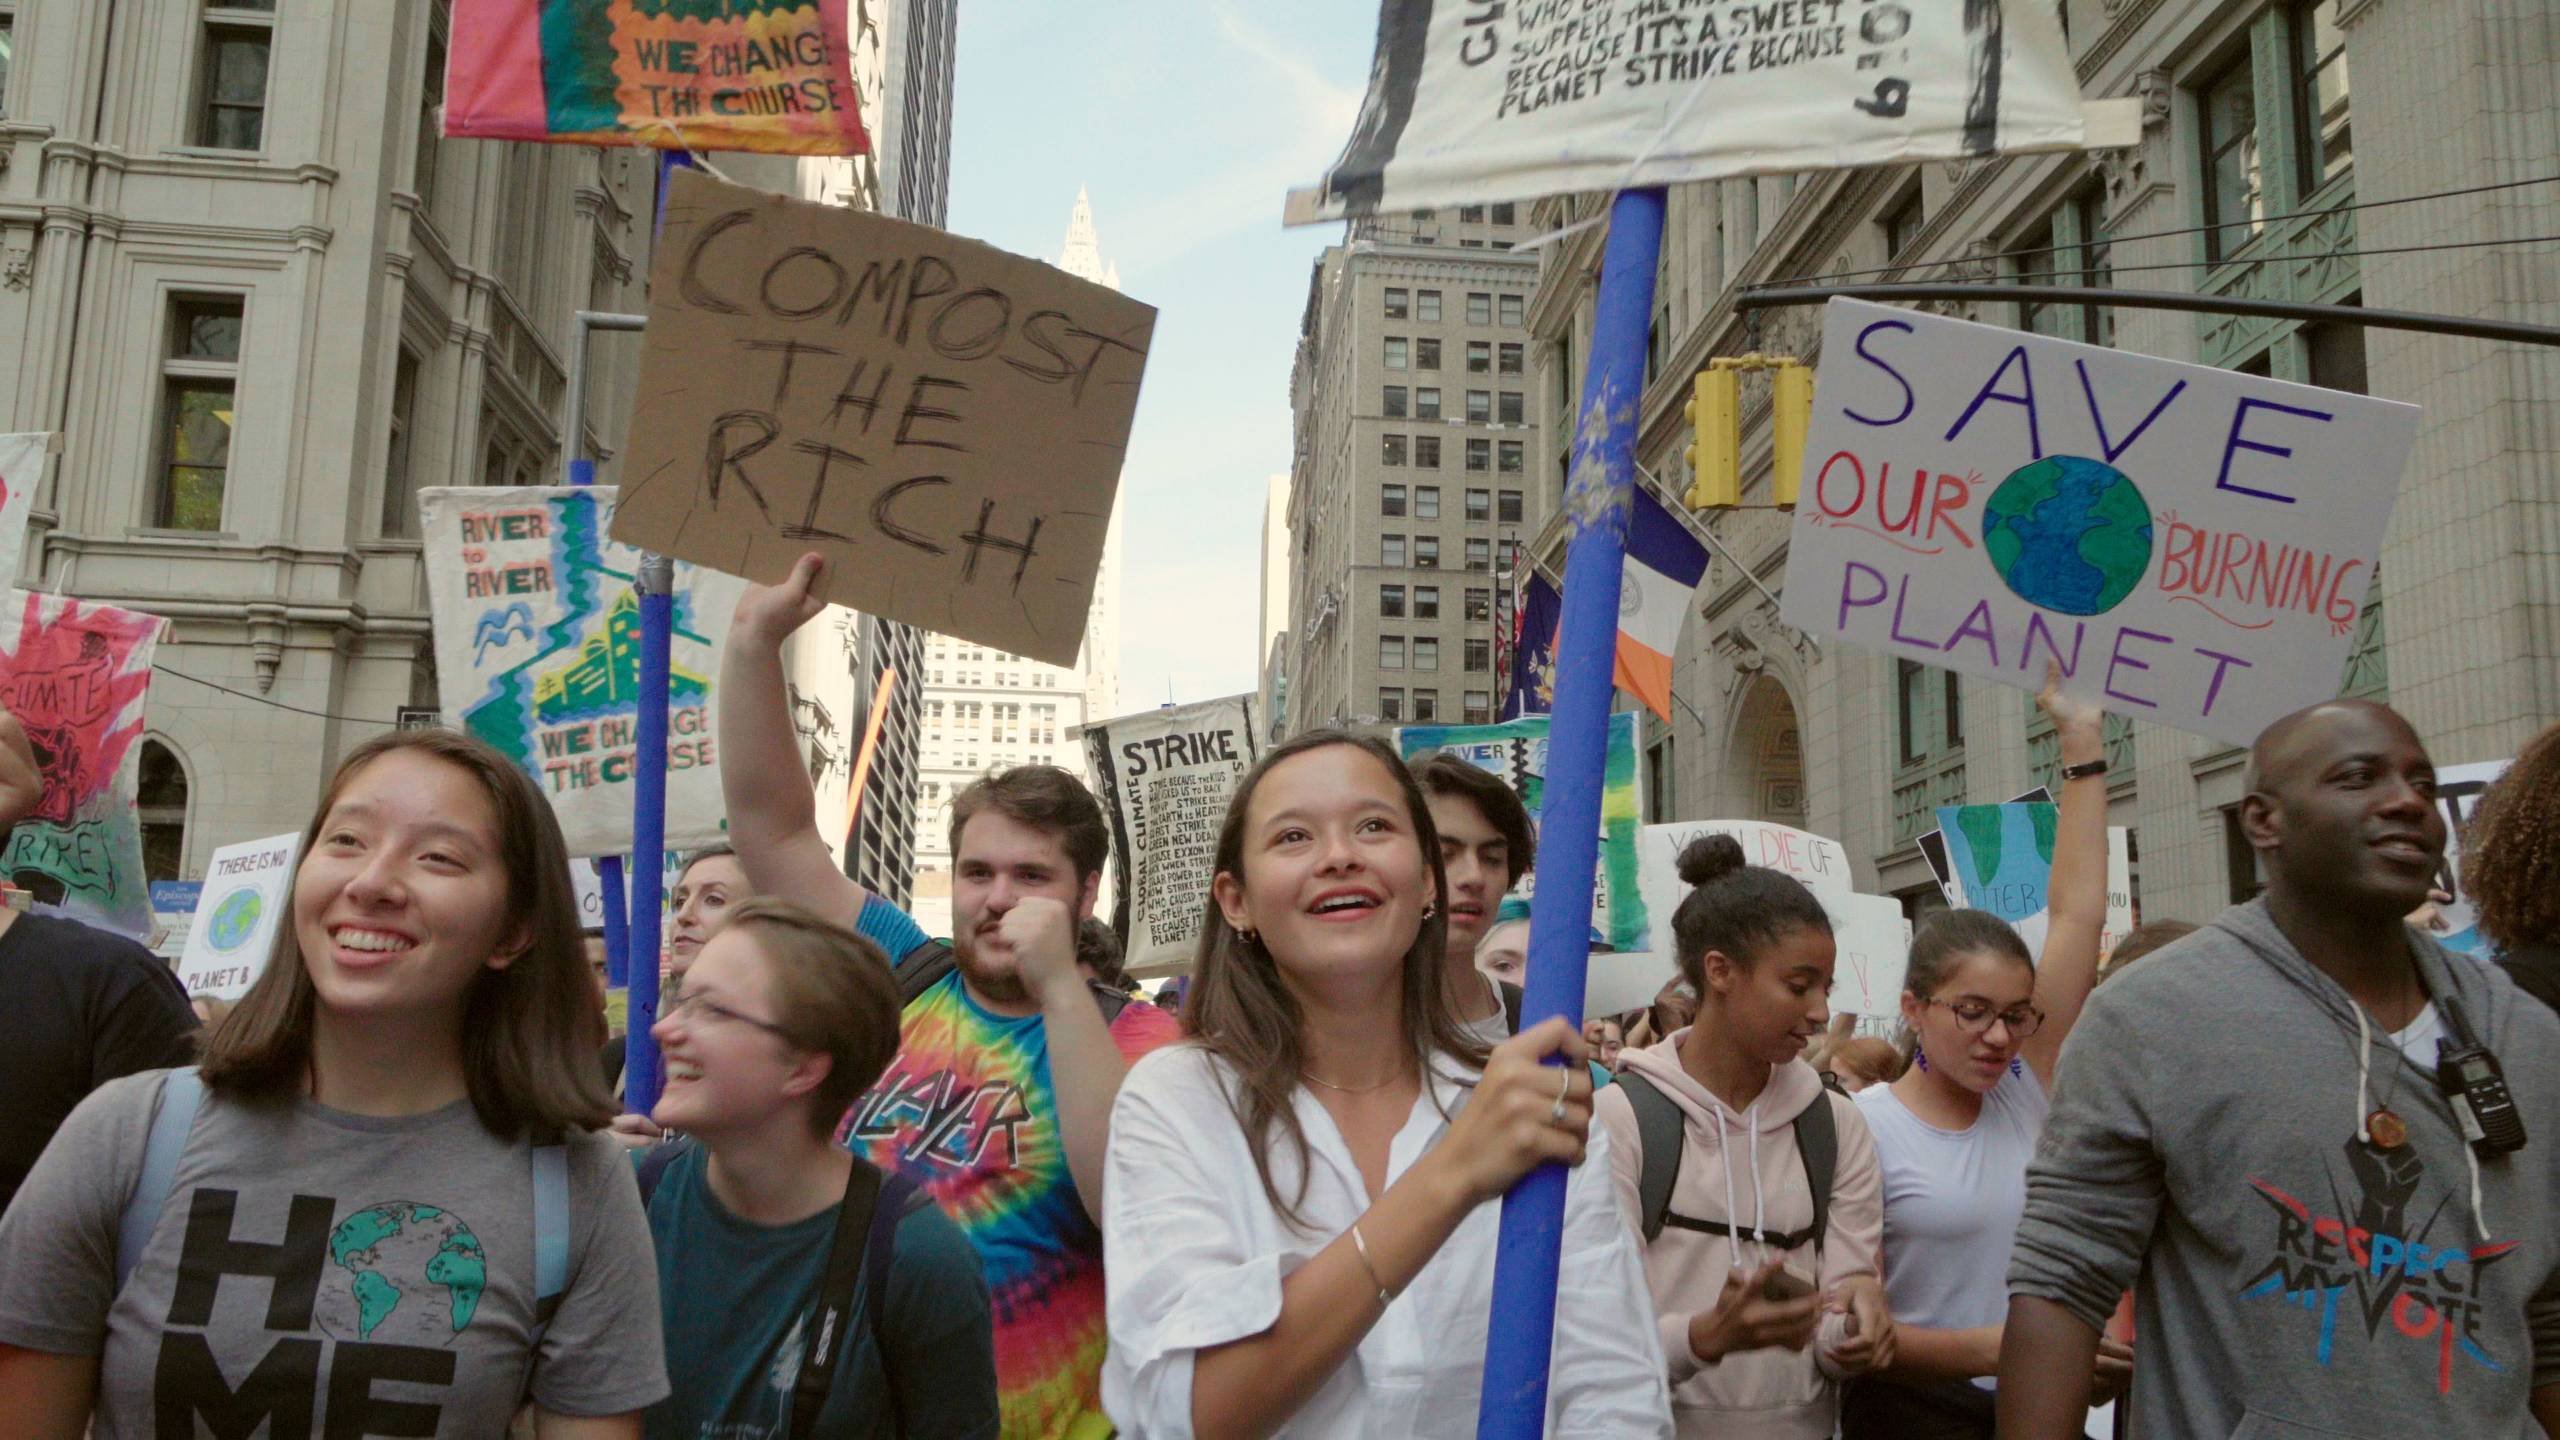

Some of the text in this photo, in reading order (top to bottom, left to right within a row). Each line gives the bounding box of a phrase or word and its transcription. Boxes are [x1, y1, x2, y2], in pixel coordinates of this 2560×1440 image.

[1507, 33, 1625, 91] BECAUSE
[1699, 13, 1718, 43] A
[1730, 0, 1843, 36] SWEET
[1510, 8, 1613, 64] SUFFER
[635, 38, 699, 74] WE
[1497, 66, 1607, 120] PLANET
[1749, 25, 1846, 72] BECAUSE
[711, 78, 843, 116] COURSE
[680, 207, 1147, 408] COMPOST
[736, 340, 972, 453] THE
[1842, 319, 2334, 503] SAVE
[706, 409, 1047, 600] RICH
[461, 511, 548, 544] RIVER
[1816, 450, 2364, 625] OUR BURNING
[466, 564, 552, 599] RIVER
[1838, 561, 2254, 718] PLANET
[541, 706, 708, 759] WE CHGE
[1122, 730, 1238, 777] STRIKE
[545, 757, 600, 793] THE
[1169, 775, 1196, 786] BECAUSE
[1209, 771, 1226, 783] KIDS
[1181, 786, 1190, 796] US
[1127, 777, 1147, 851] CLIMATE
[1159, 811, 1182, 823] EARTH
[1177, 797, 1207, 808] STRIKE
[1172, 833, 1192, 845] NEW
[1176, 819, 1207, 833] STRIKE
[14, 831, 98, 876] RIKE
[217, 849, 288, 877] THERE IS NO
[1162, 860, 1185, 870] WHEN
[1174, 846, 1204, 858] EXXON
[1759, 828, 1804, 872] DIE
[1808, 838, 1832, 876] OF
[1167, 870, 1193, 882] POWER
[1167, 881, 1194, 893] STRIKE
[1147, 897, 1166, 910] WHO
[1169, 892, 1196, 906] CAUSED
[1148, 906, 1183, 924] SUFFER
[1150, 917, 1190, 935] BECAUSE
[1151, 929, 1186, 946] PLANET
[187, 966, 249, 991] PLANET B
[2247, 1174, 2522, 1300] RESPECT
